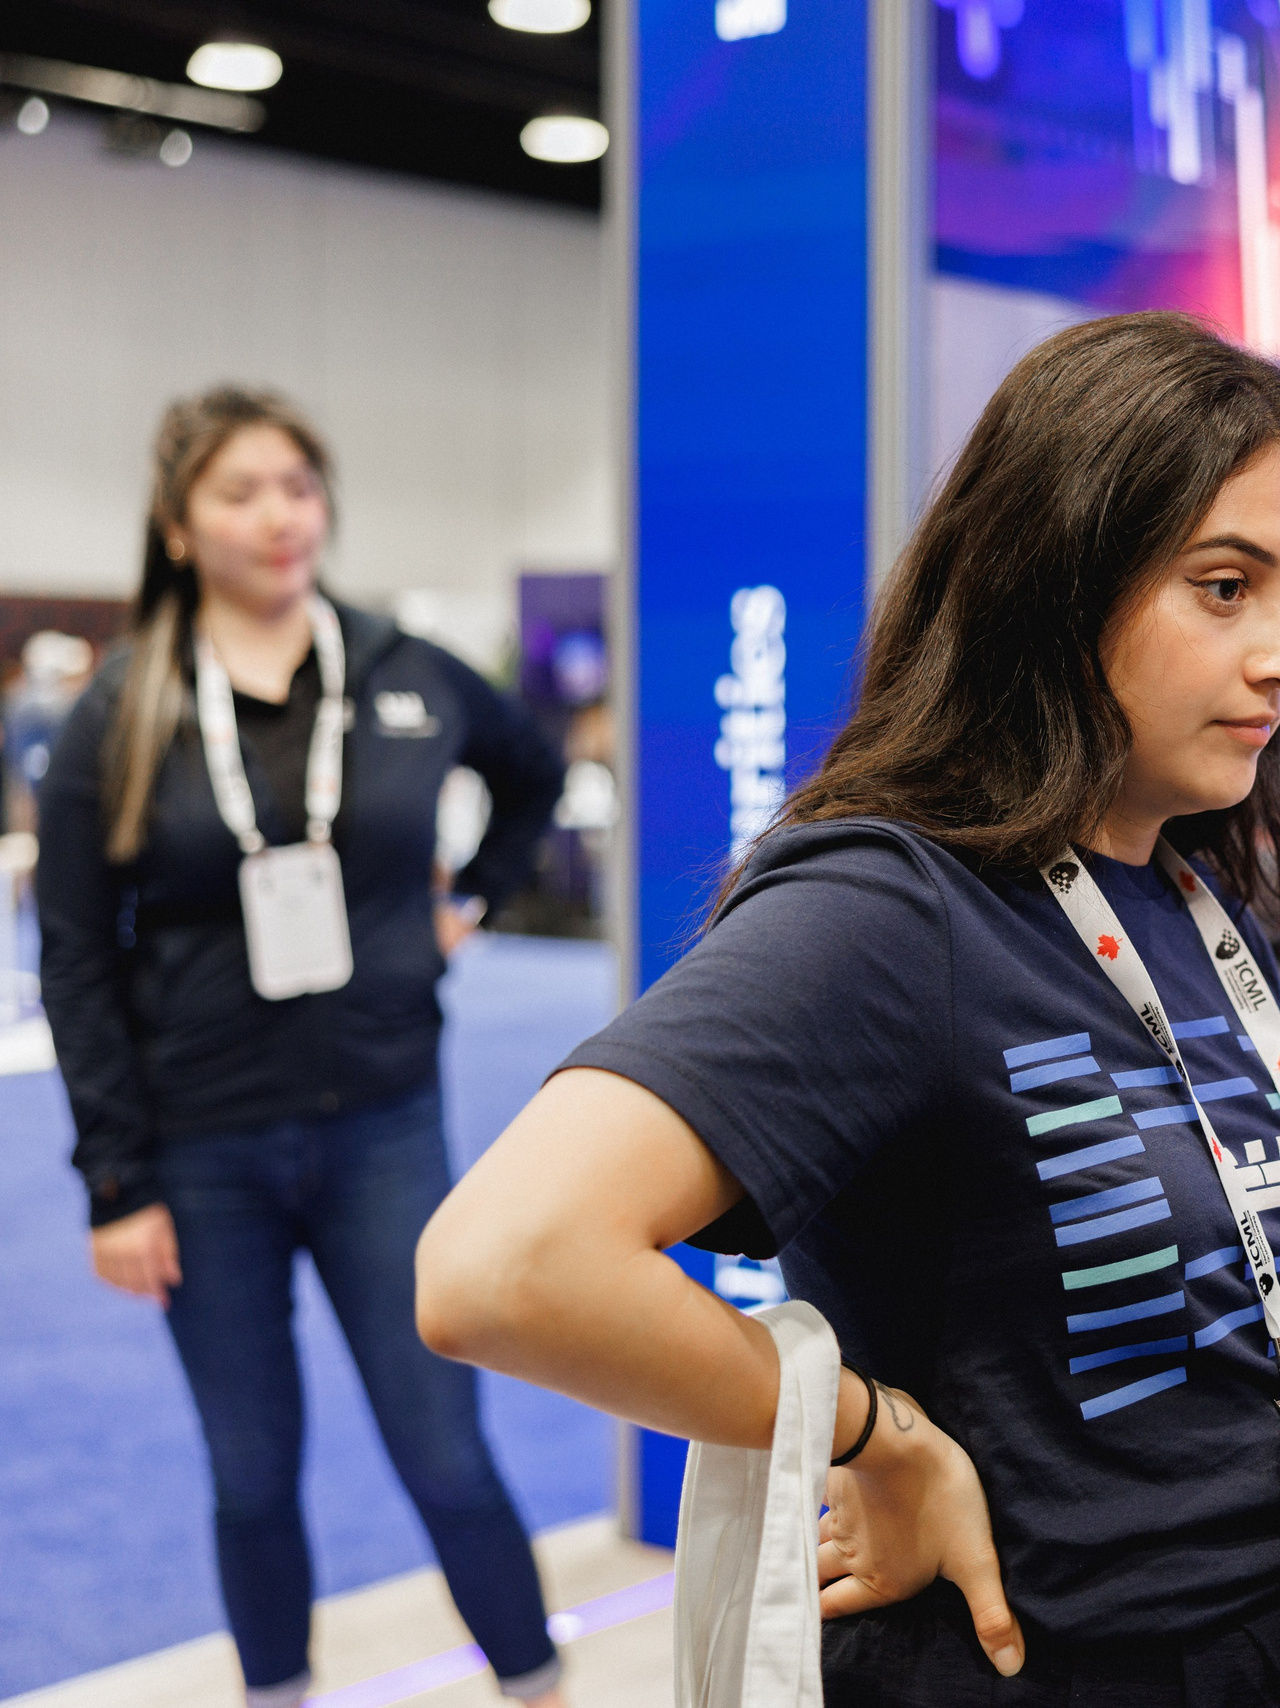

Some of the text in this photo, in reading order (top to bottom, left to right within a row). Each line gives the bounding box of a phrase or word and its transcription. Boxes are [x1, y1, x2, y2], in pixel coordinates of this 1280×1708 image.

[1234, 959, 1267, 1011] ICML
[1140, 1003, 1173, 1055] ICML
[1240, 1211, 1263, 1270] ICML
